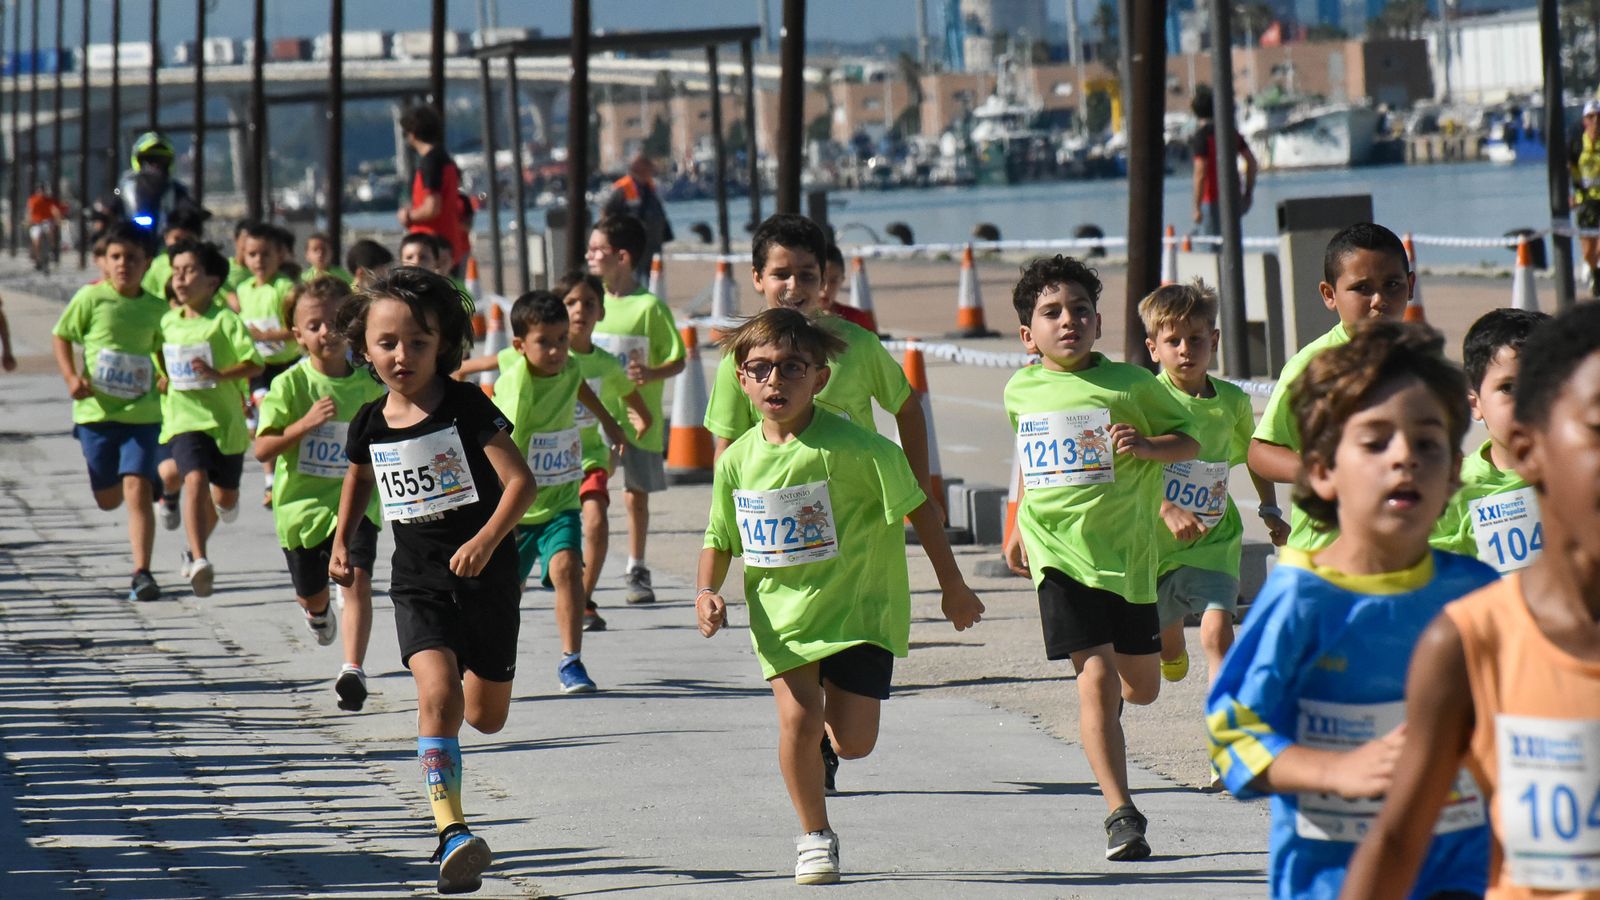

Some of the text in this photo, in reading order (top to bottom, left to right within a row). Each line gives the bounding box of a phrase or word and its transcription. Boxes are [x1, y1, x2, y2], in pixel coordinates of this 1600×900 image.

[99, 367, 133, 385] 1044
[1020, 421, 1033, 433] XXI
[374, 451, 387, 463] XXI
[1023, 438, 1077, 468] 1213
[381, 465, 435, 498] 1555
[737, 496, 750, 509] XXI
[779, 490, 811, 501] ANTONIO
[1501, 500, 1524, 509] Carrera
[1502, 507, 1526, 517] Popular
[1477, 504, 1501, 522] XXI
[743, 516, 799, 546] 1472
[1488, 521, 1544, 565] 104
